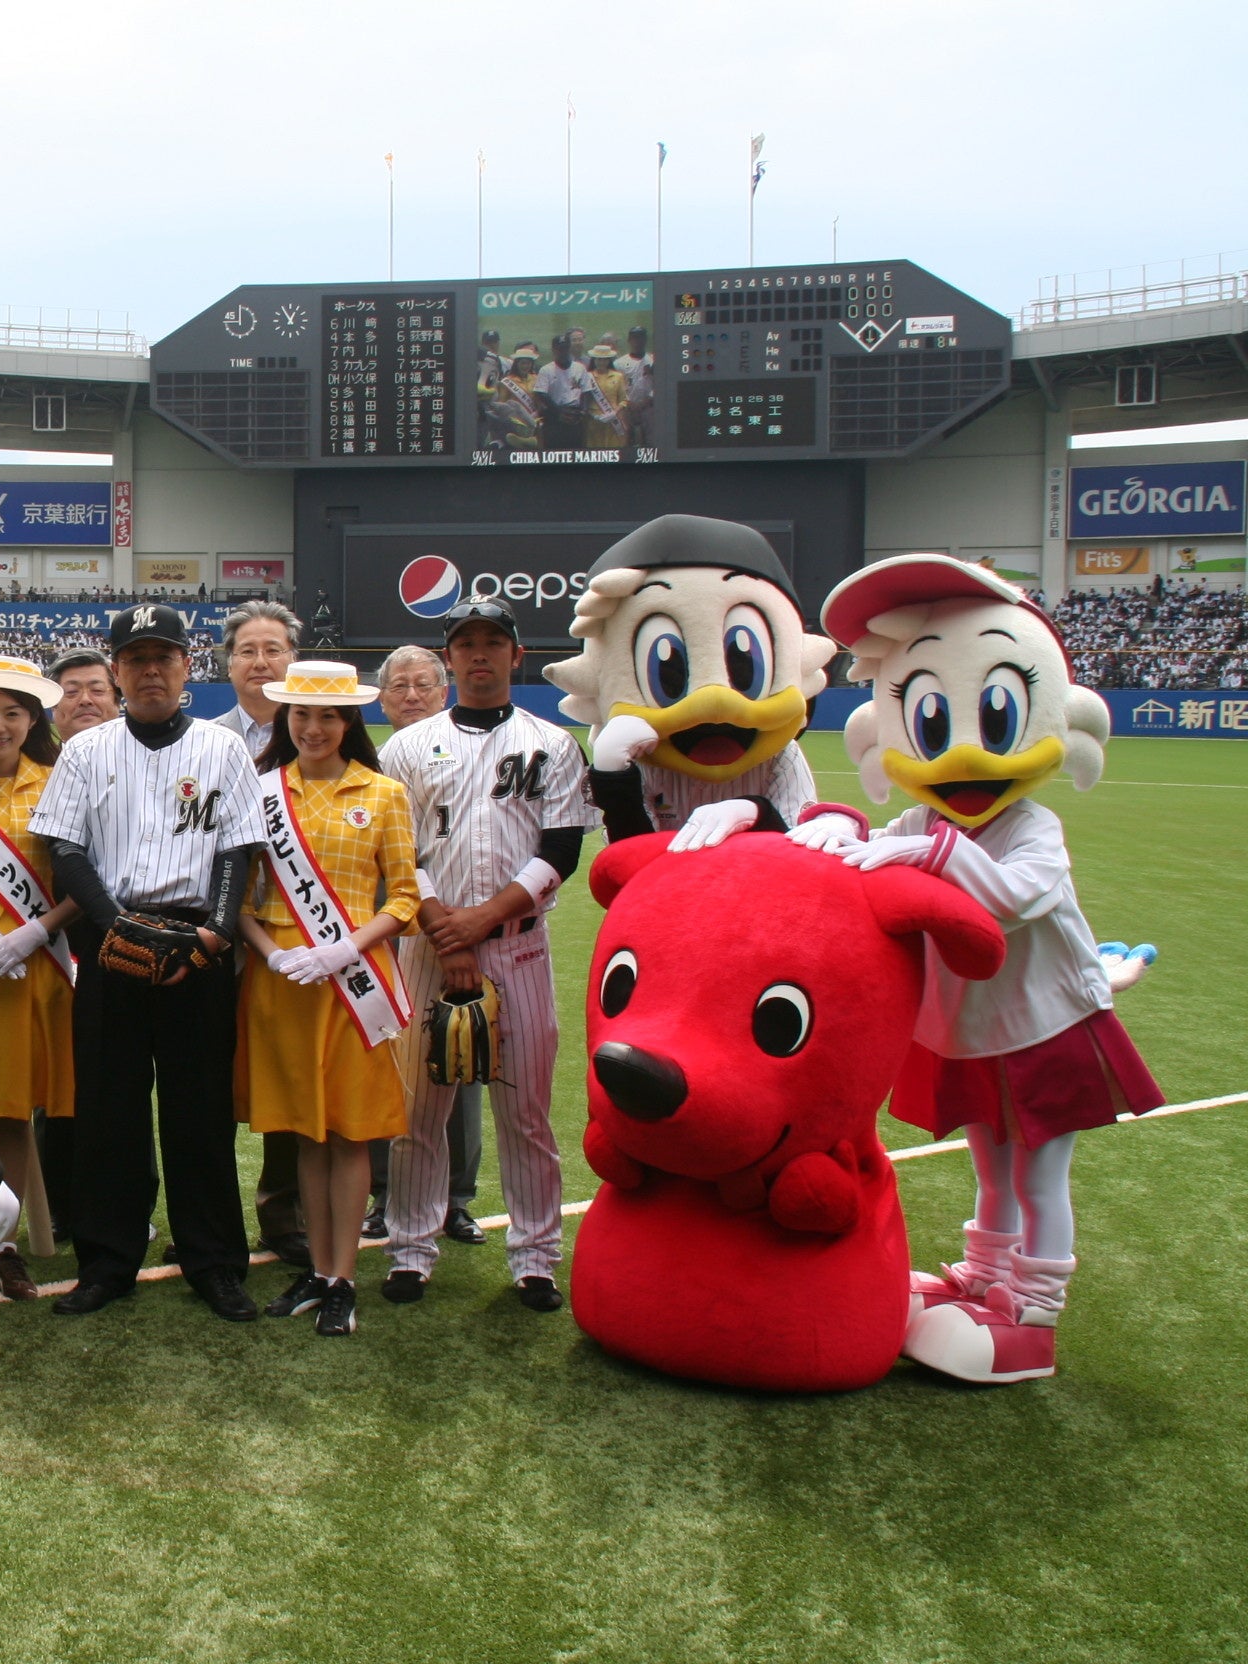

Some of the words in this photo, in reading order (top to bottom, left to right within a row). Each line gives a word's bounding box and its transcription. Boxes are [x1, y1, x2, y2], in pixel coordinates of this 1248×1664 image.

[708, 281, 713, 289] 1
[721, 281, 728, 289] 2
[735, 280, 742, 288] 3
[749, 279, 756, 287] 4
[762, 278, 769, 287] 5
[776, 278, 784, 286] 6
[791, 277, 798, 286] 7
[804, 277, 811, 285] 8
[818, 276, 825, 284] 9
[830, 275, 841, 284] 10
[848, 274, 856, 283] R
[867, 273, 874, 282] H
[884, 272, 891, 281] E
[482, 288, 648, 308] QVCマリンフィールド
[335, 301, 376, 311] ホークス
[397, 300, 448, 310] マリーンズ
[331, 319, 338, 329] 6
[397, 317, 405, 327] 8
[331, 332, 338, 343] 4
[397, 331, 405, 341] 6
[682, 335, 689, 344] B
[937, 336, 945, 348] 8
[331, 346, 338, 357] 7
[397, 345, 405, 355] 4
[682, 350, 689, 359] S
[230, 359, 252, 367] TIME
[331, 360, 338, 371] 3
[397, 359, 405, 369] 7
[328, 374, 340, 384] DH
[395, 373, 406, 383] DH
[330, 388, 338, 398] 9
[397, 387, 405, 397] 3
[768, 394, 784, 402] 3B
[330, 401, 338, 412] 5
[397, 400, 405, 411] 9
[330, 415, 338, 426] 8
[397, 414, 405, 425] 2
[330, 429, 338, 440] 2
[397, 428, 405, 438] 5
[332, 443, 336, 453] 1
[398, 442, 402, 452] 1
[510, 451, 540, 464] CHIBA
[542, 451, 573, 463] LOTTE
[574, 450, 619, 463] MARINES
[1078, 476, 1230, 517] GEORGIA
[22, 503, 108, 525] 京葉銀行
[1085, 551, 1122, 568] Fit's
[471, 572, 588, 608] peps
[131, 606, 157, 633] M
[202, 617, 227, 626] Twel
[427, 759, 457, 767] NEXON
[491, 750, 549, 801] M
[173, 788, 222, 836] M
[435, 805, 451, 839] 1
[263, 792, 376, 1000] ちばピーナッツ使
